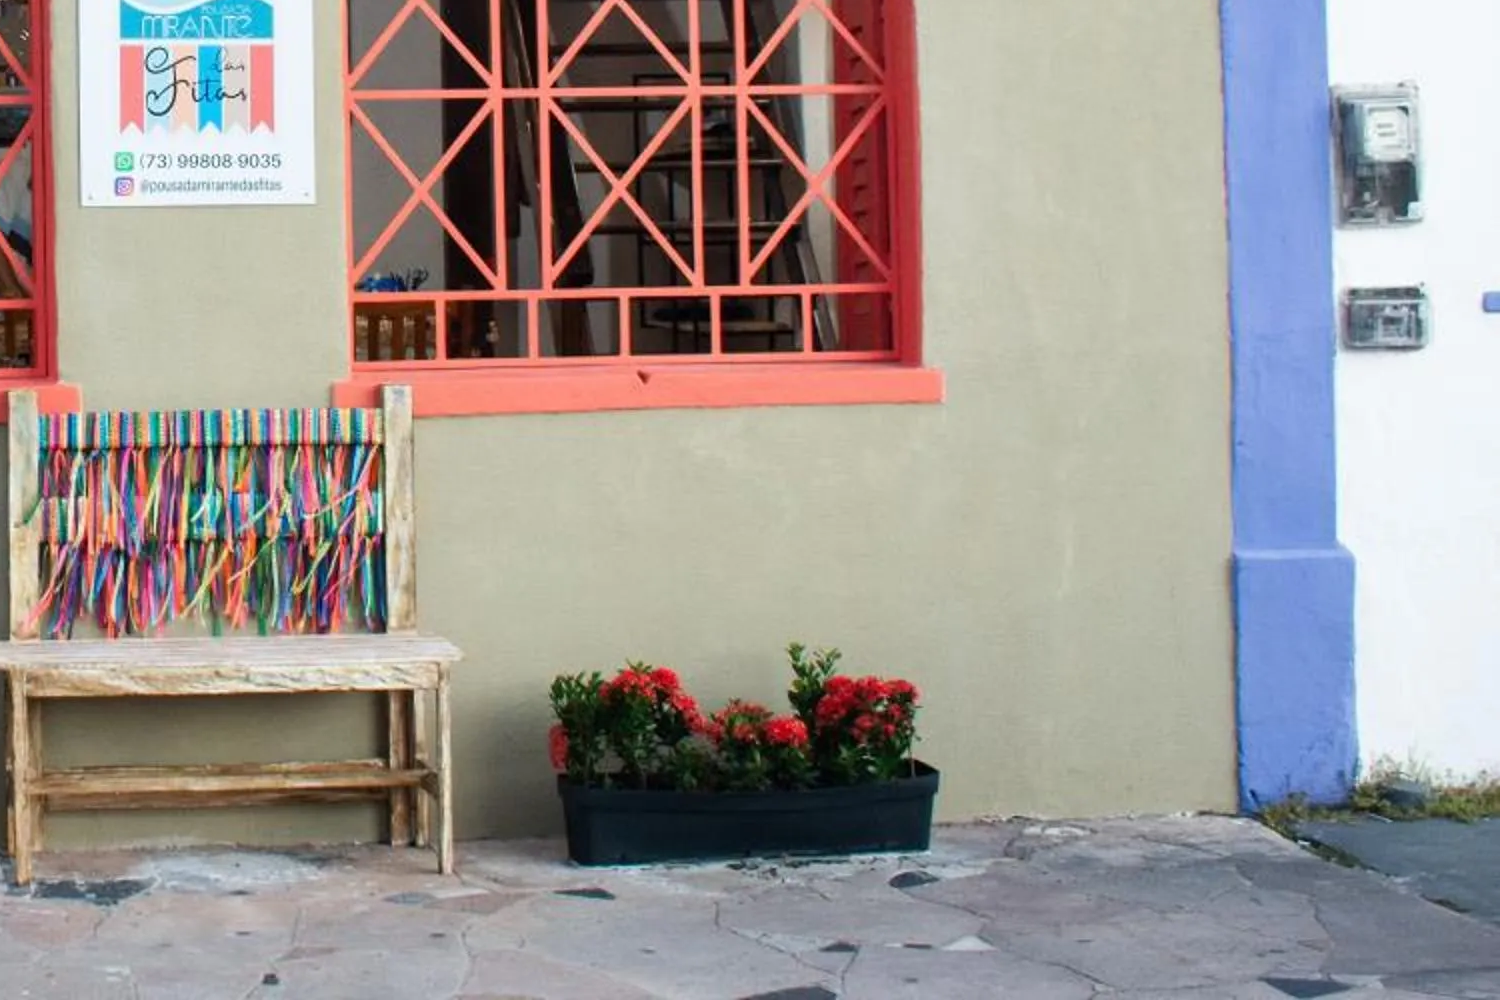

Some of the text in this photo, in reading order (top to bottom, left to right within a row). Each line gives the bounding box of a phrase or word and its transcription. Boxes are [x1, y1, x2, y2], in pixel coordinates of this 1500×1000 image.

[211, 47, 245, 72] das
[145, 46, 247, 117] Fitas
[139, 153, 282, 169] (73) 99808 9035
